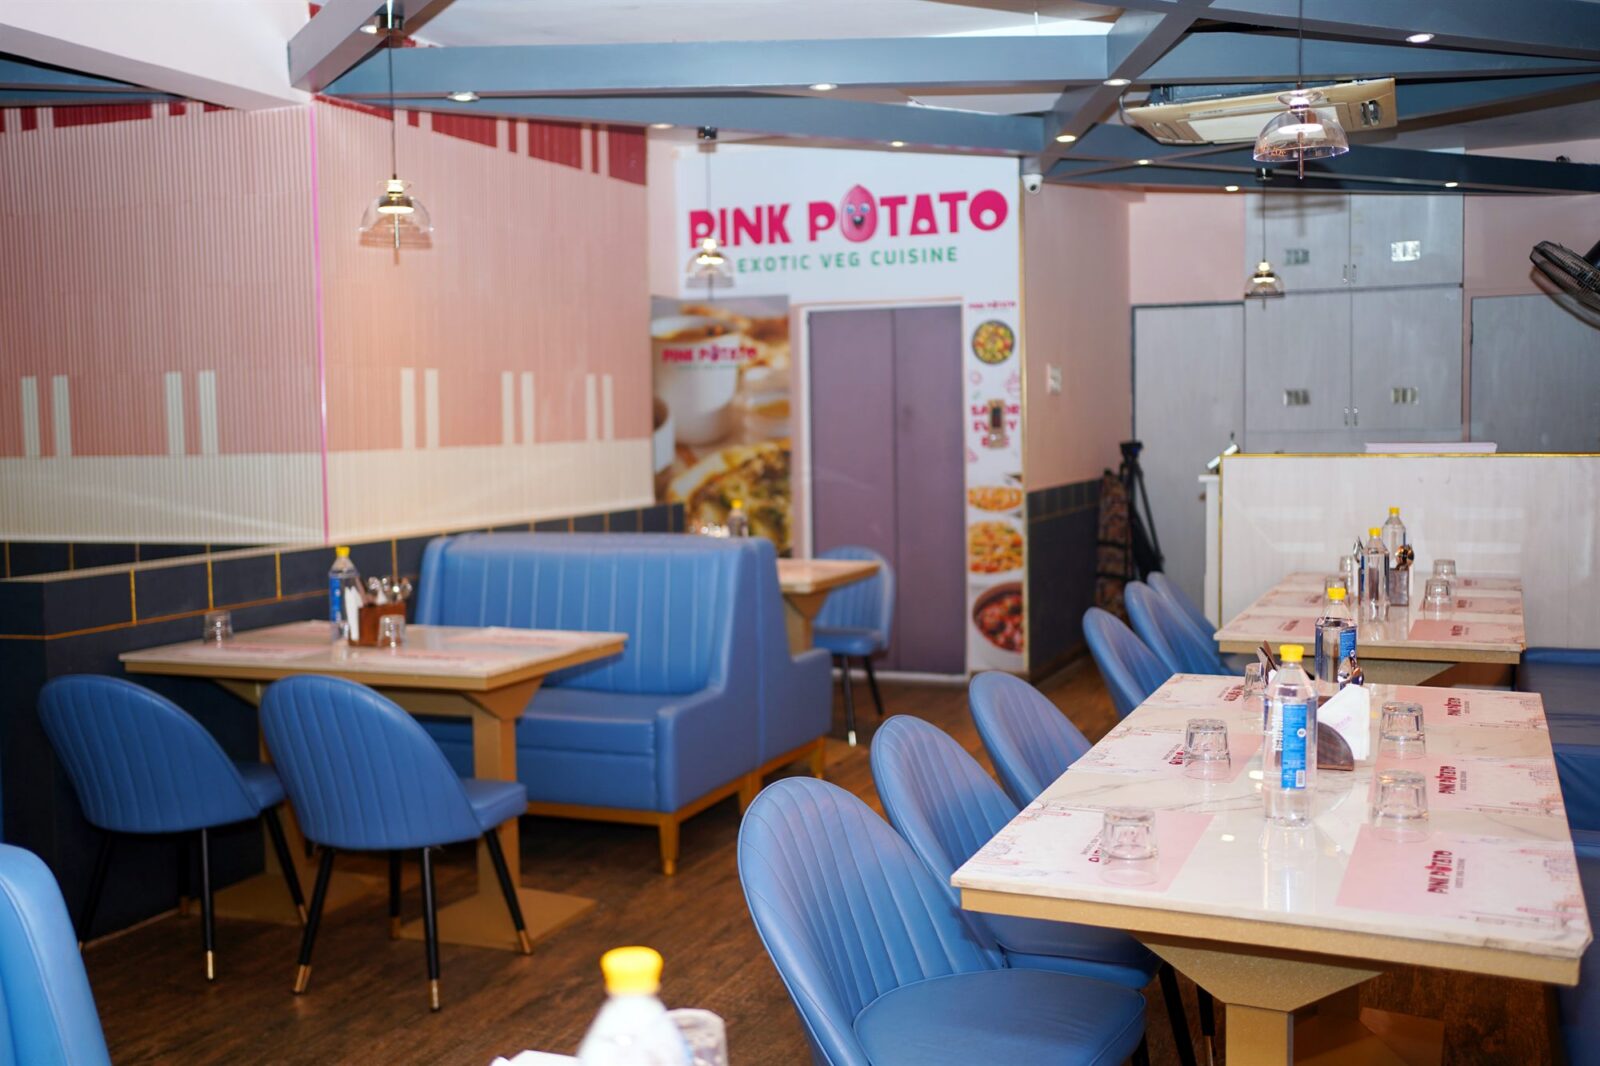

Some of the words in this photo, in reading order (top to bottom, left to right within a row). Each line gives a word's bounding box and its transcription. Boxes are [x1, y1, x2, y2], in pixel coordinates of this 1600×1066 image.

[690, 204, 791, 248] PINK
[808, 184, 1008, 243] POTATO
[738, 255, 810, 273] EXOTIC
[820, 252, 861, 269] VEG
[871, 246, 958, 266] CUISINE
[1427, 877, 1450, 894] PINK
